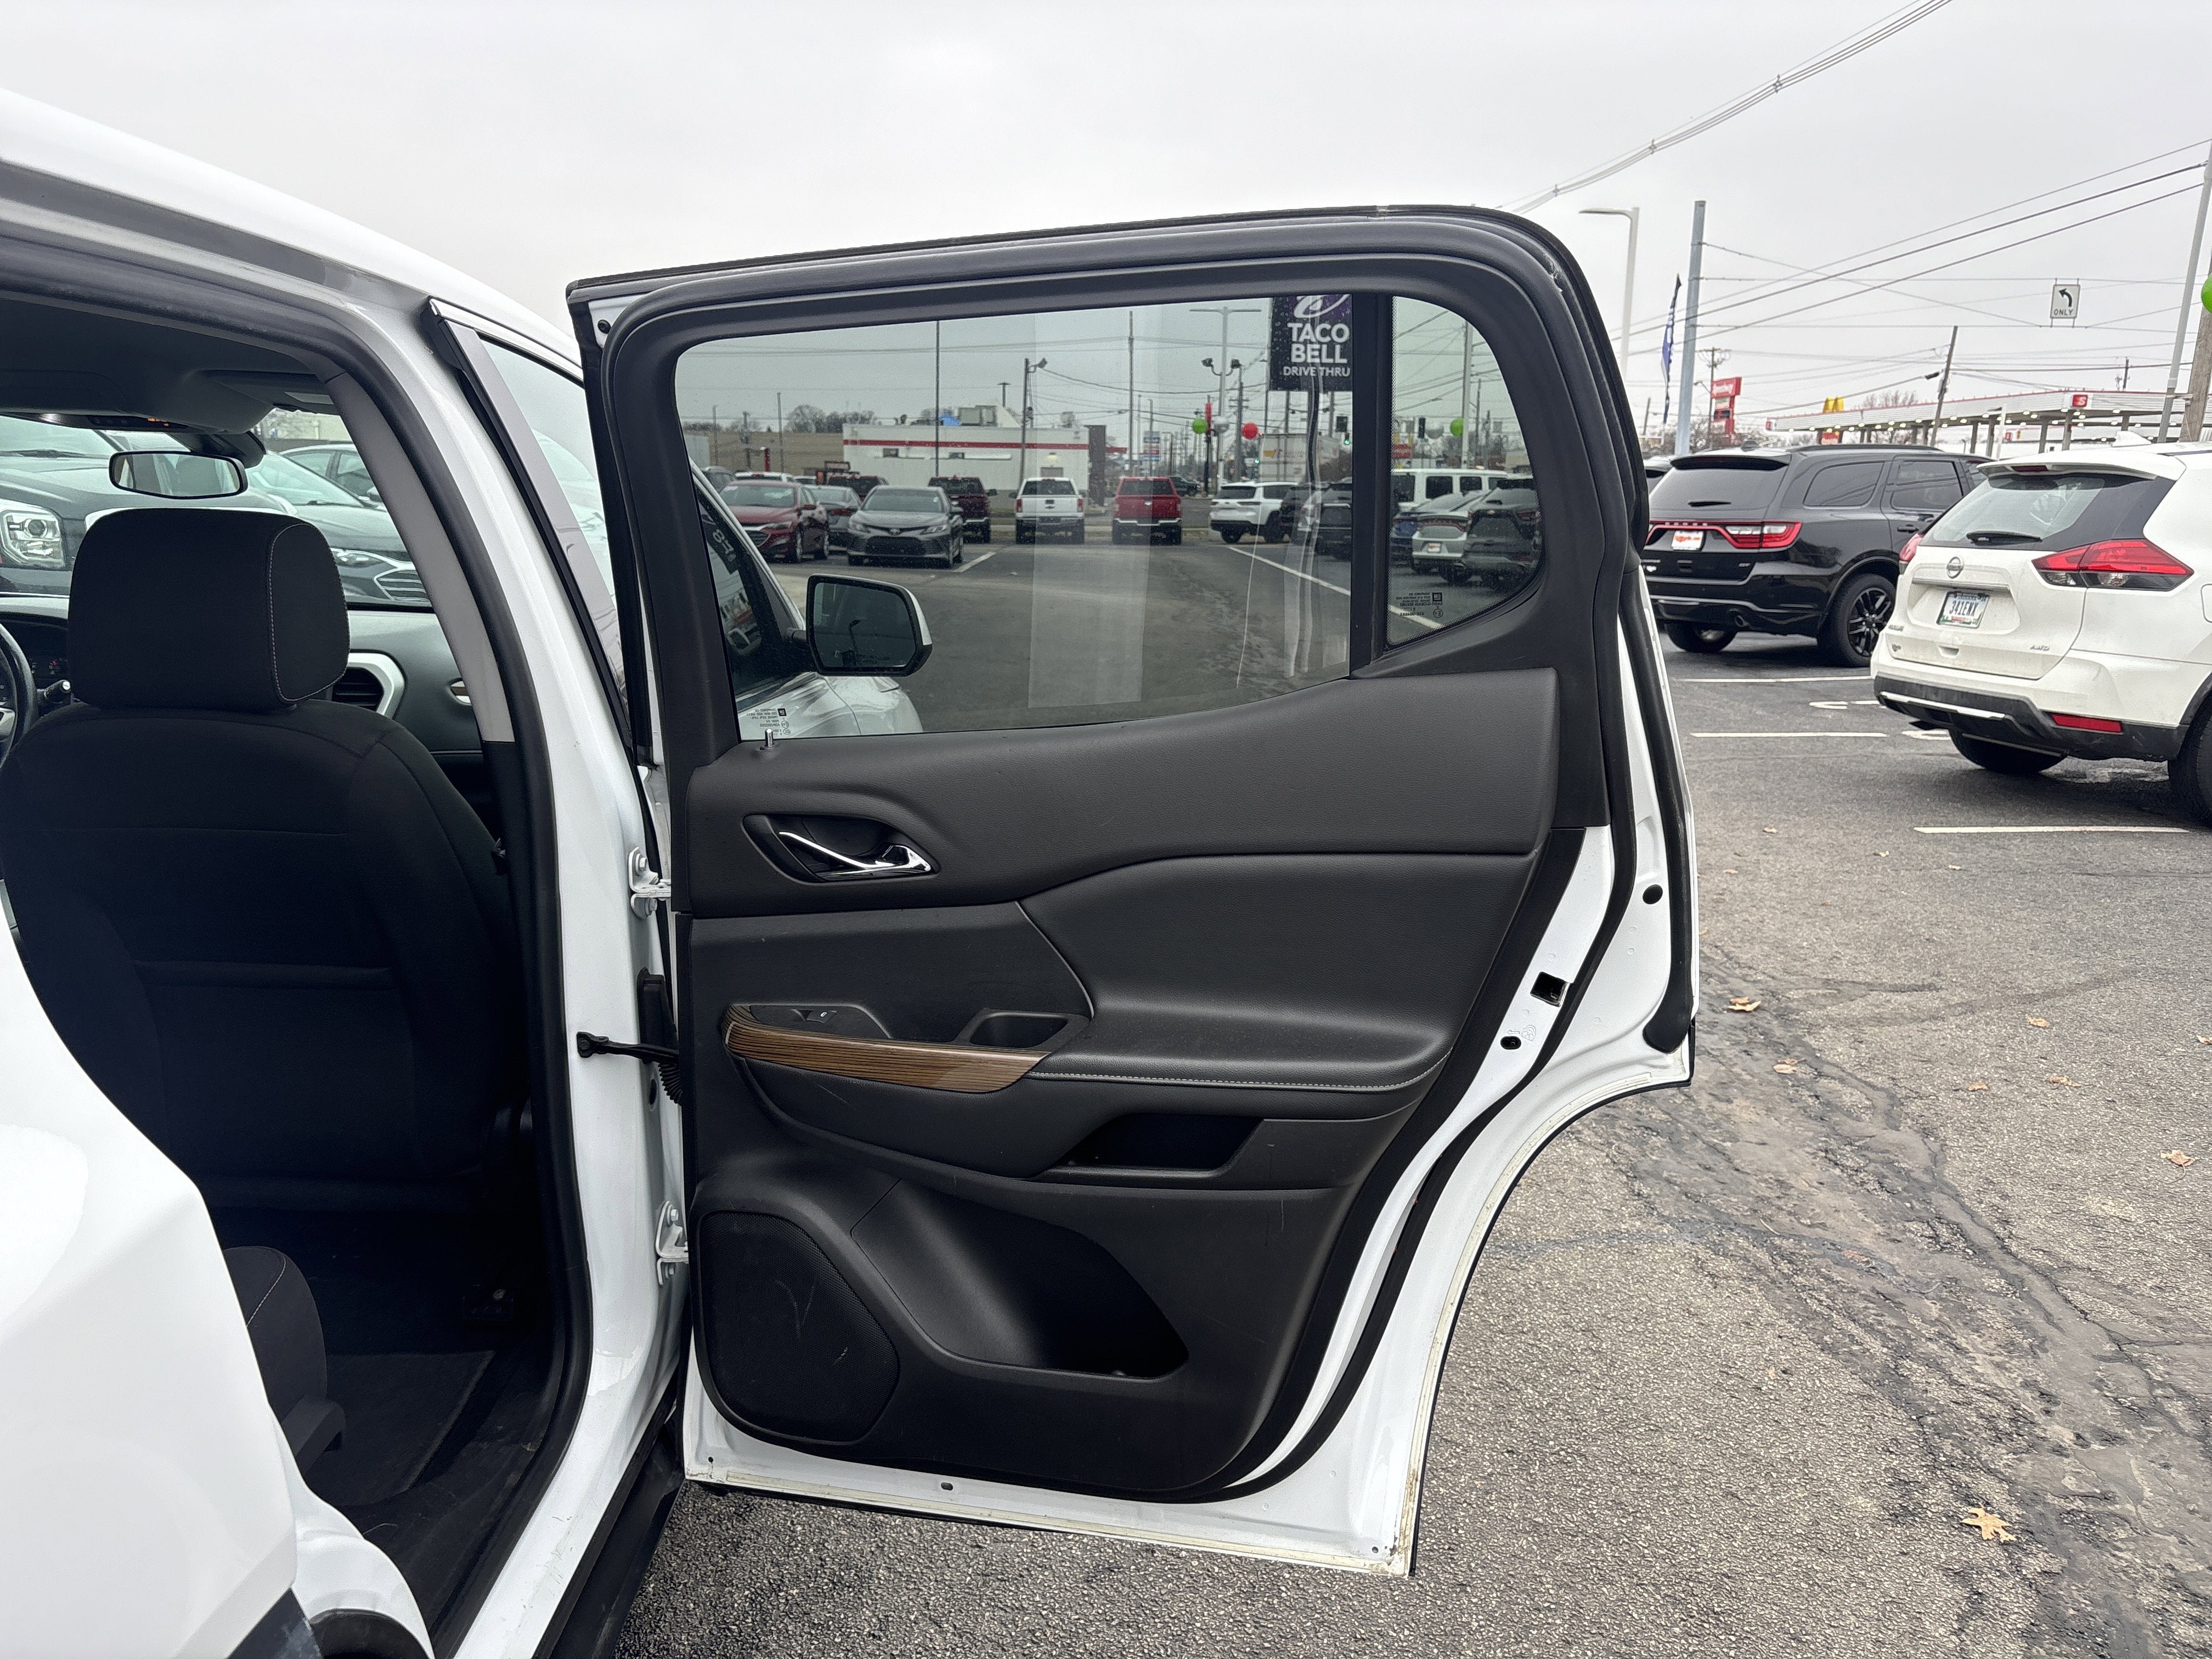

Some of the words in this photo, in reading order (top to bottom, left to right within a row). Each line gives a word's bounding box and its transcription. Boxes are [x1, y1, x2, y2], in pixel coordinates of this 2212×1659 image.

[1287, 323, 1350, 343] TACO
[1291, 343, 1348, 364] BELL
[1283, 366, 1316, 376] DRIVE
[1318, 366, 1351, 377] THRU
